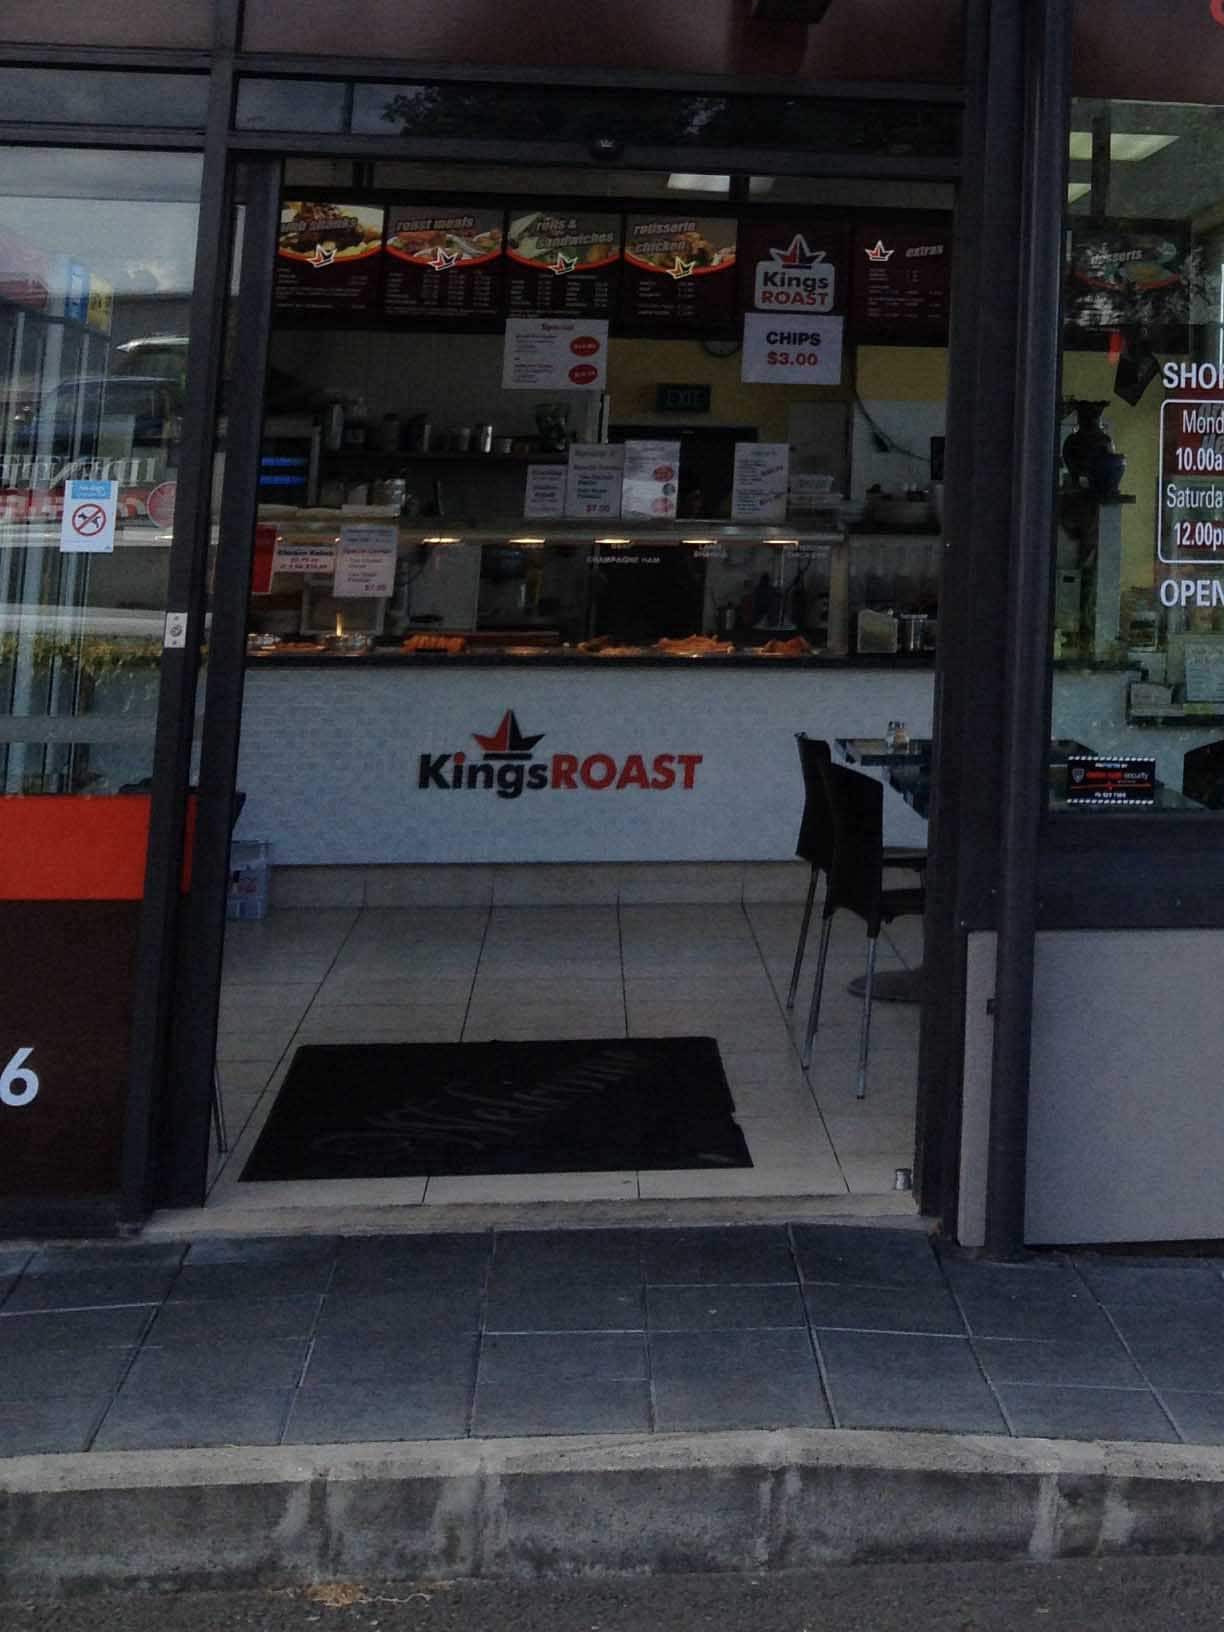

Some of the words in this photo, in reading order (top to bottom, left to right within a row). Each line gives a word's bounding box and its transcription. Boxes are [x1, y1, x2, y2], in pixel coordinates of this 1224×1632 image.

[763, 271, 829, 292] Kings
[760, 291, 828, 305] ROAST
[766, 331, 822, 346] CHIPS
[767, 352, 818, 366] $3.00
[0, 1047, 40, 1107] 6
